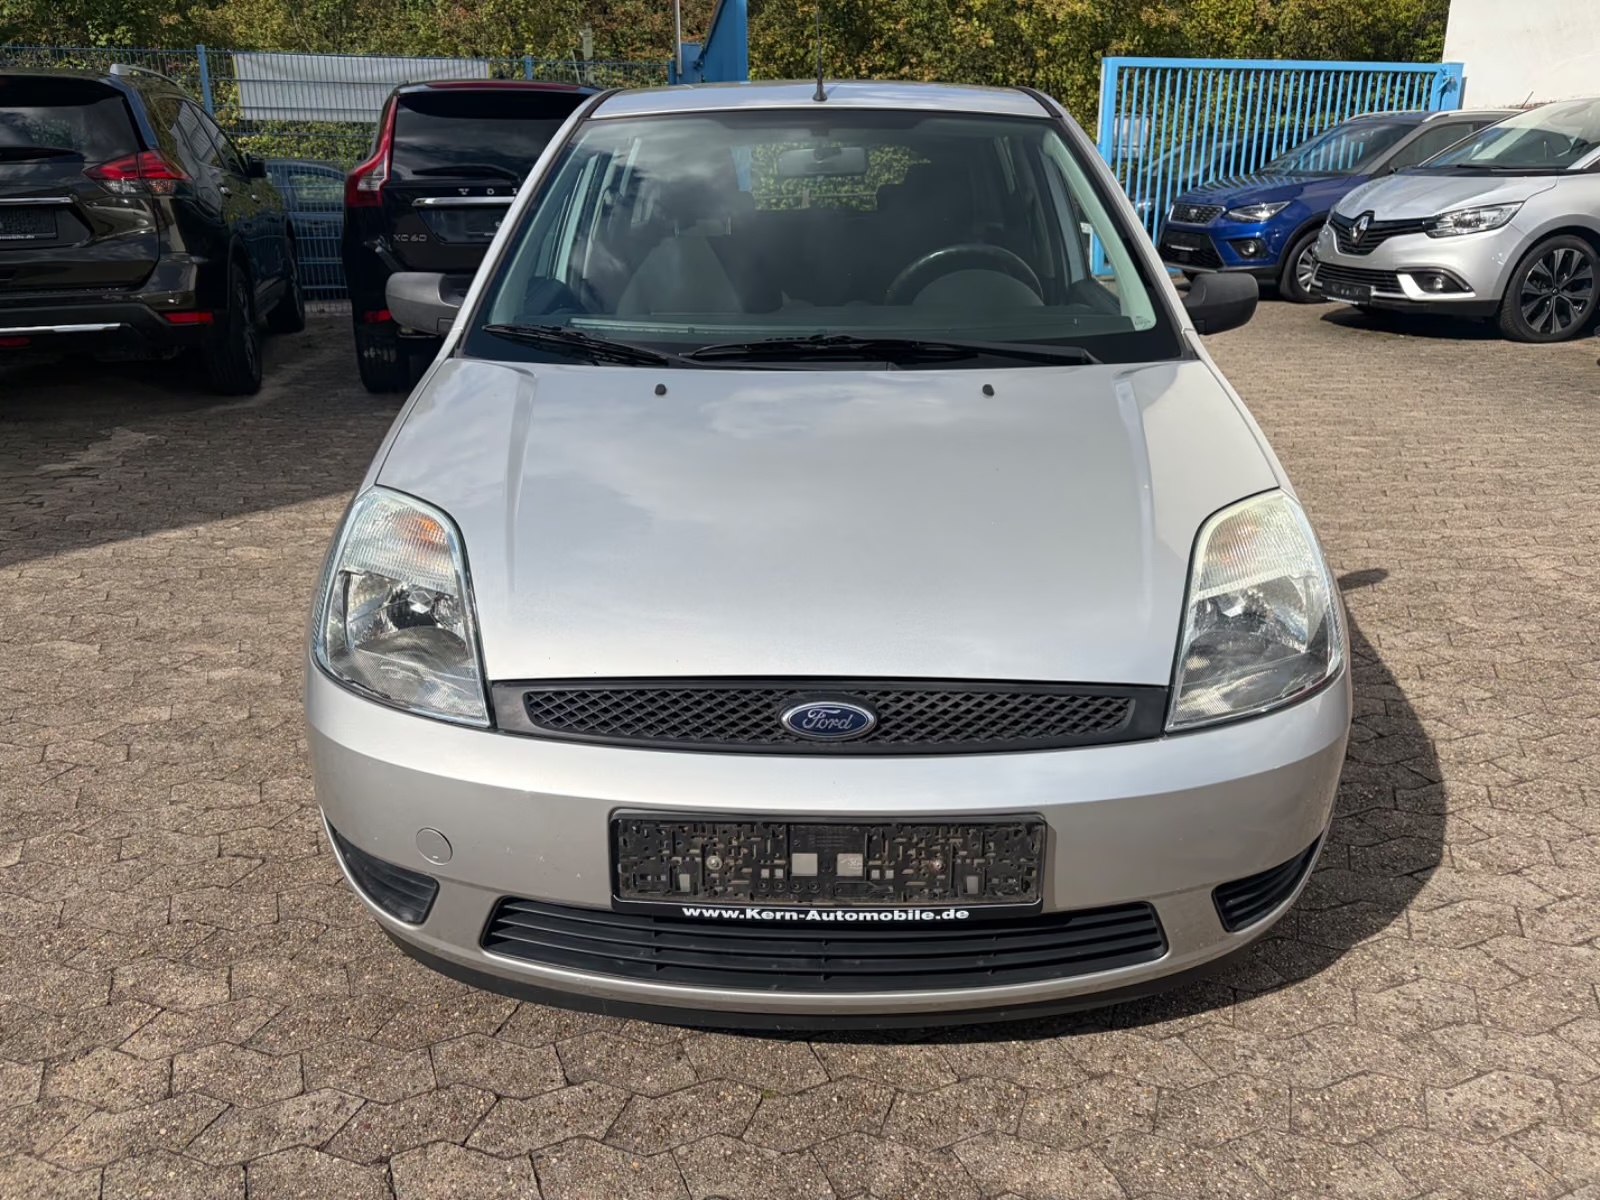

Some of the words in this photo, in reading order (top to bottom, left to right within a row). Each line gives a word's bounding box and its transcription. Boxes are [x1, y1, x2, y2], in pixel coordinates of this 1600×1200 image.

[393, 233, 427, 242] XC60
[802, 708, 854, 730] Ford
[682, 907, 970, 921] www.Kern-Automobile.de
